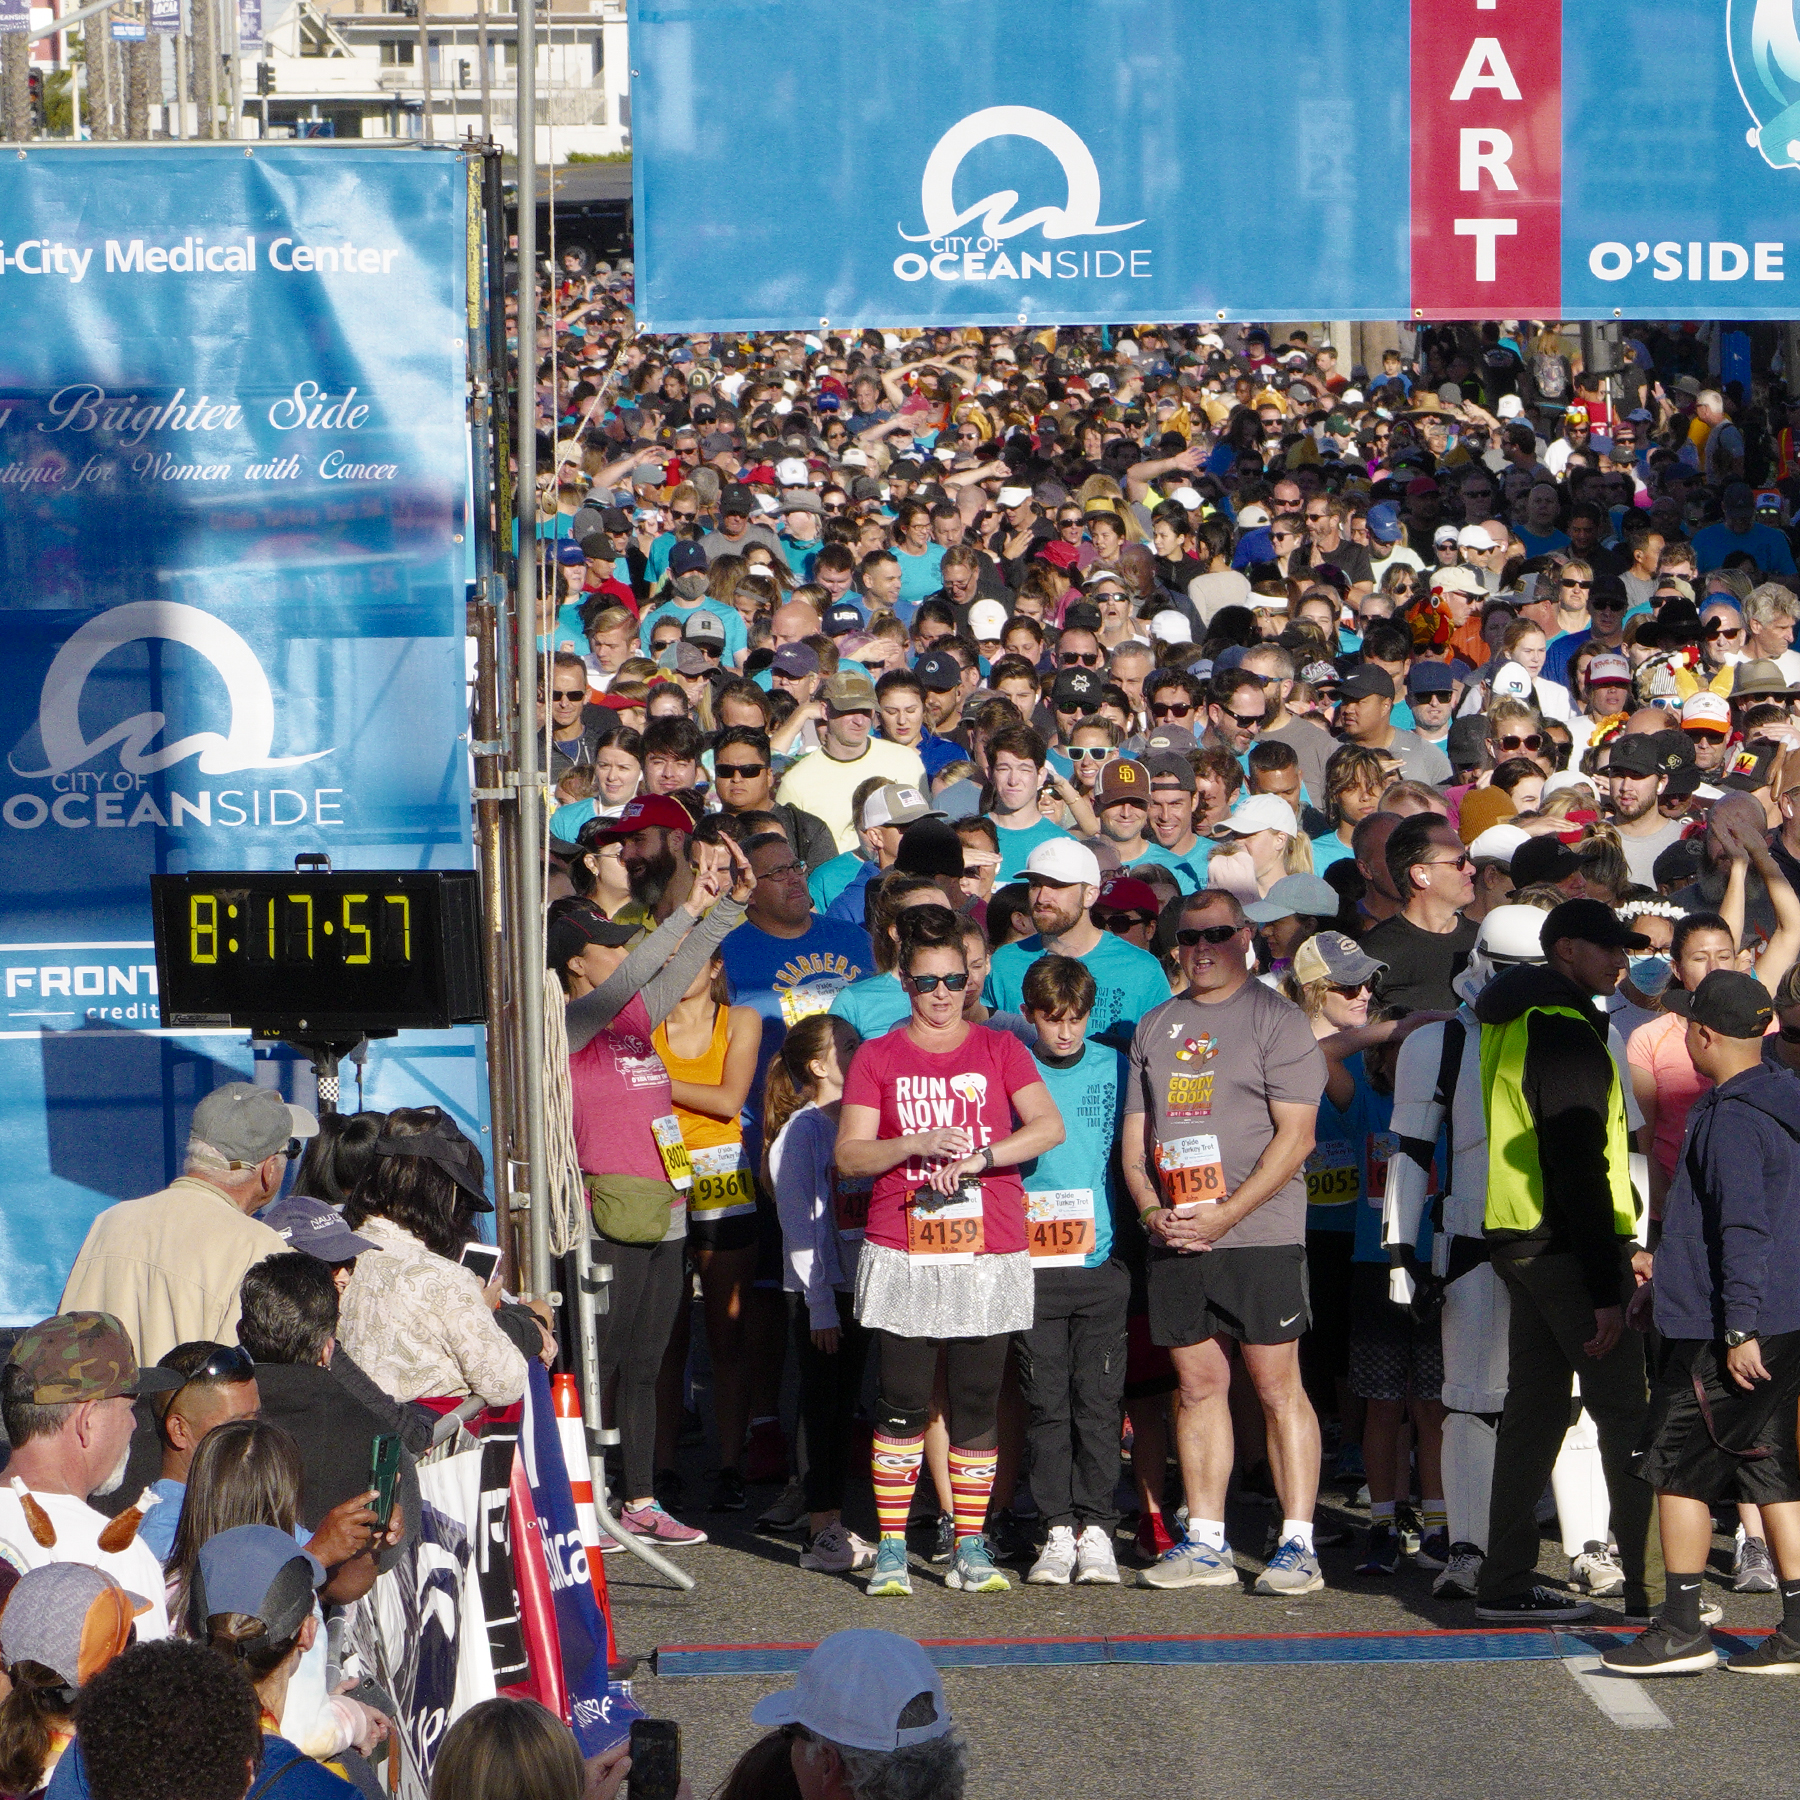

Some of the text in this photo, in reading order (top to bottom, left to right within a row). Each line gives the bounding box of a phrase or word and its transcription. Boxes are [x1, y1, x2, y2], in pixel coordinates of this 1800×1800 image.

[1449, 0, 1523, 282] ART
[105, 236, 256, 273] Medical
[269, 237, 399, 274] Center
[929, 236, 1004, 254] CITY OF
[893, 248, 1153, 283] OCEANSIDE
[1588, 241, 1785, 283] O'SIDE
[37, 383, 244, 447] Brighter
[268, 380, 370, 431] Side
[132, 452, 242, 483] Women
[244, 452, 303, 482] with
[318, 449, 399, 481] Cancer
[833, 611, 859, 621] USA
[51, 773, 147, 793] CITY OF
[1119, 765, 1136, 783] SD
[3, 788, 345, 829] OCEANSIDE
[897, 1075, 946, 1101] RUN
[1168, 1089, 1214, 1104] GOODY
[1169, 1075, 1214, 1091] GOODY
[897, 1100, 954, 1128] NOW
[699, 1173, 749, 1201] 9361
[1167, 1166, 1219, 1195] 4158
[1309, 1169, 1360, 1196] 9055
[920, 1219, 978, 1246] 4159
[1034, 1221, 1088, 1247] 4157
